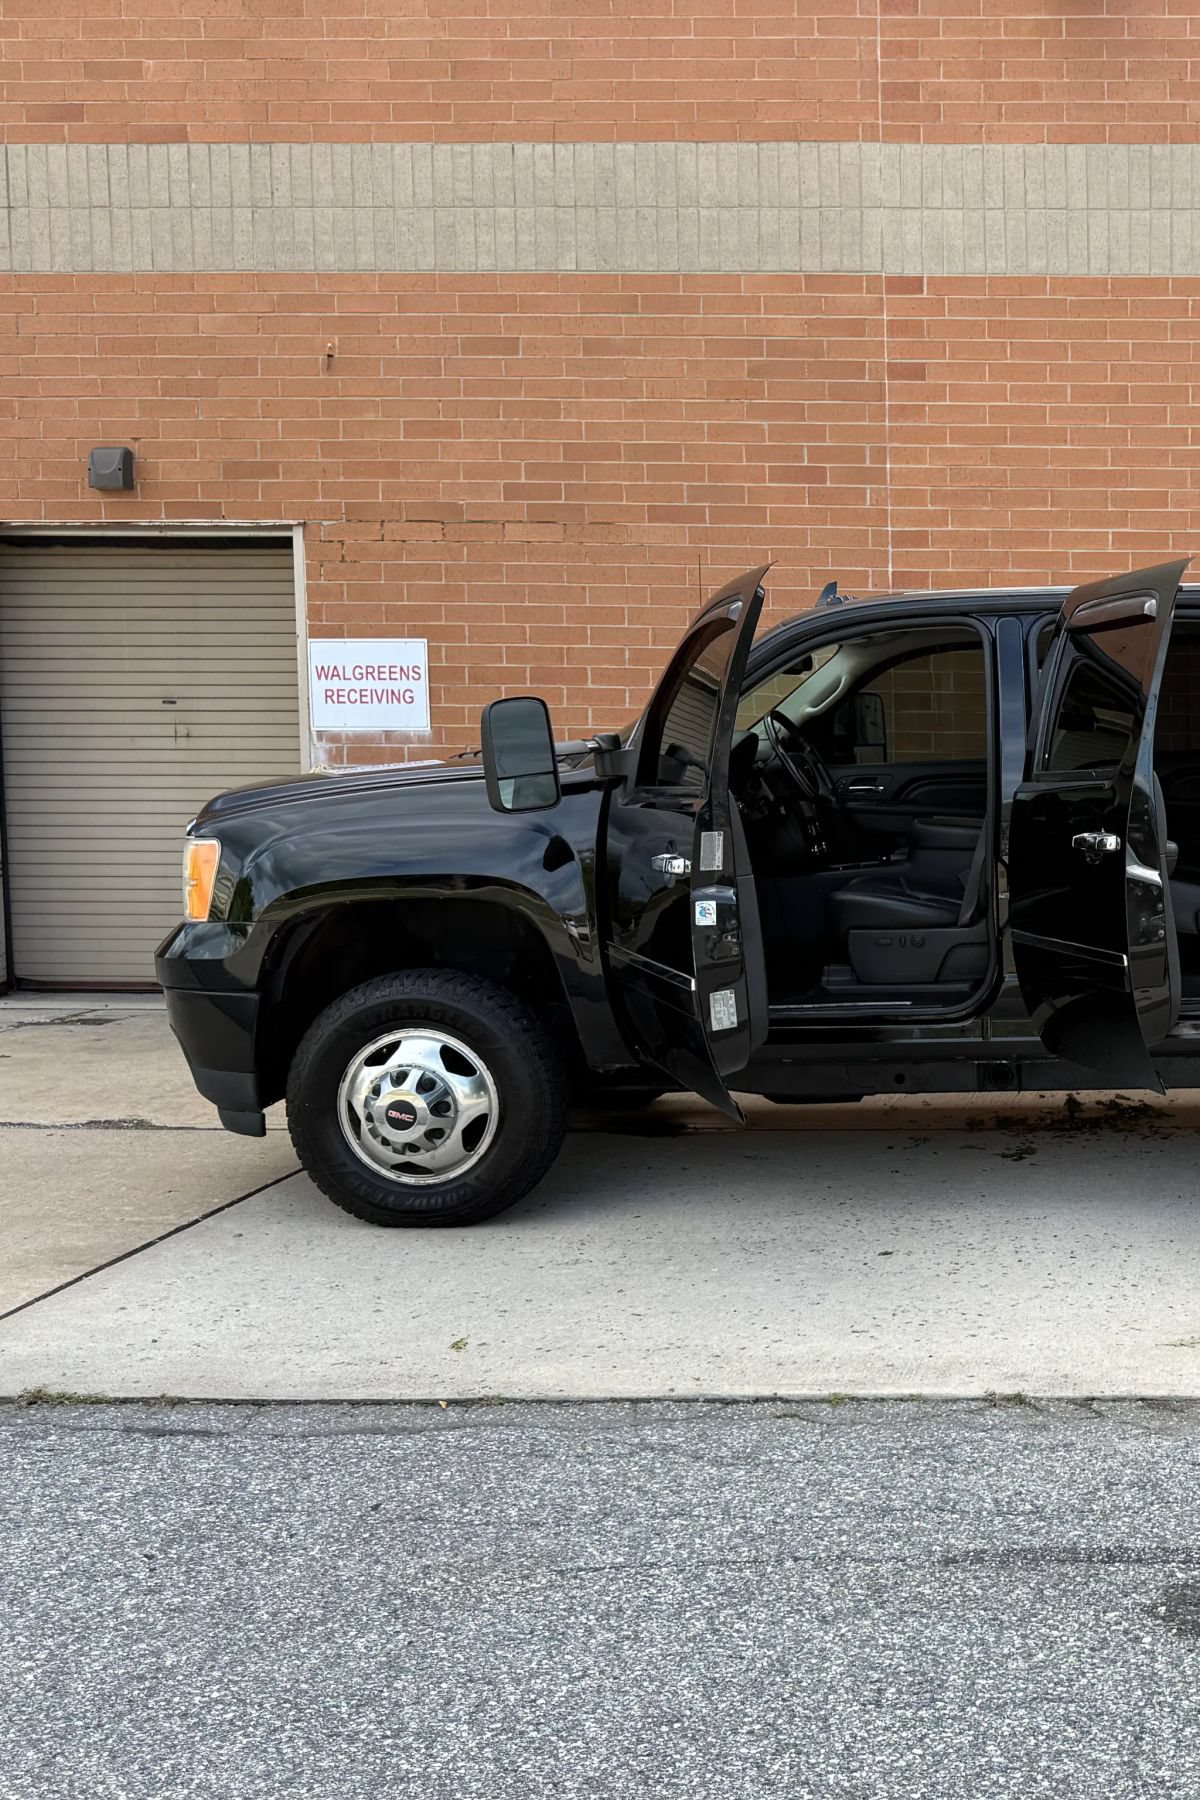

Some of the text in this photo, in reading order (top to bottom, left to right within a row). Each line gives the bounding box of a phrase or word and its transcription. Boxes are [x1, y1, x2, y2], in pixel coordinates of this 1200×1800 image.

[315, 665, 421, 681] WALGREENS
[325, 689, 414, 704] RECEIVING
[388, 1110, 414, 1122] GMC
